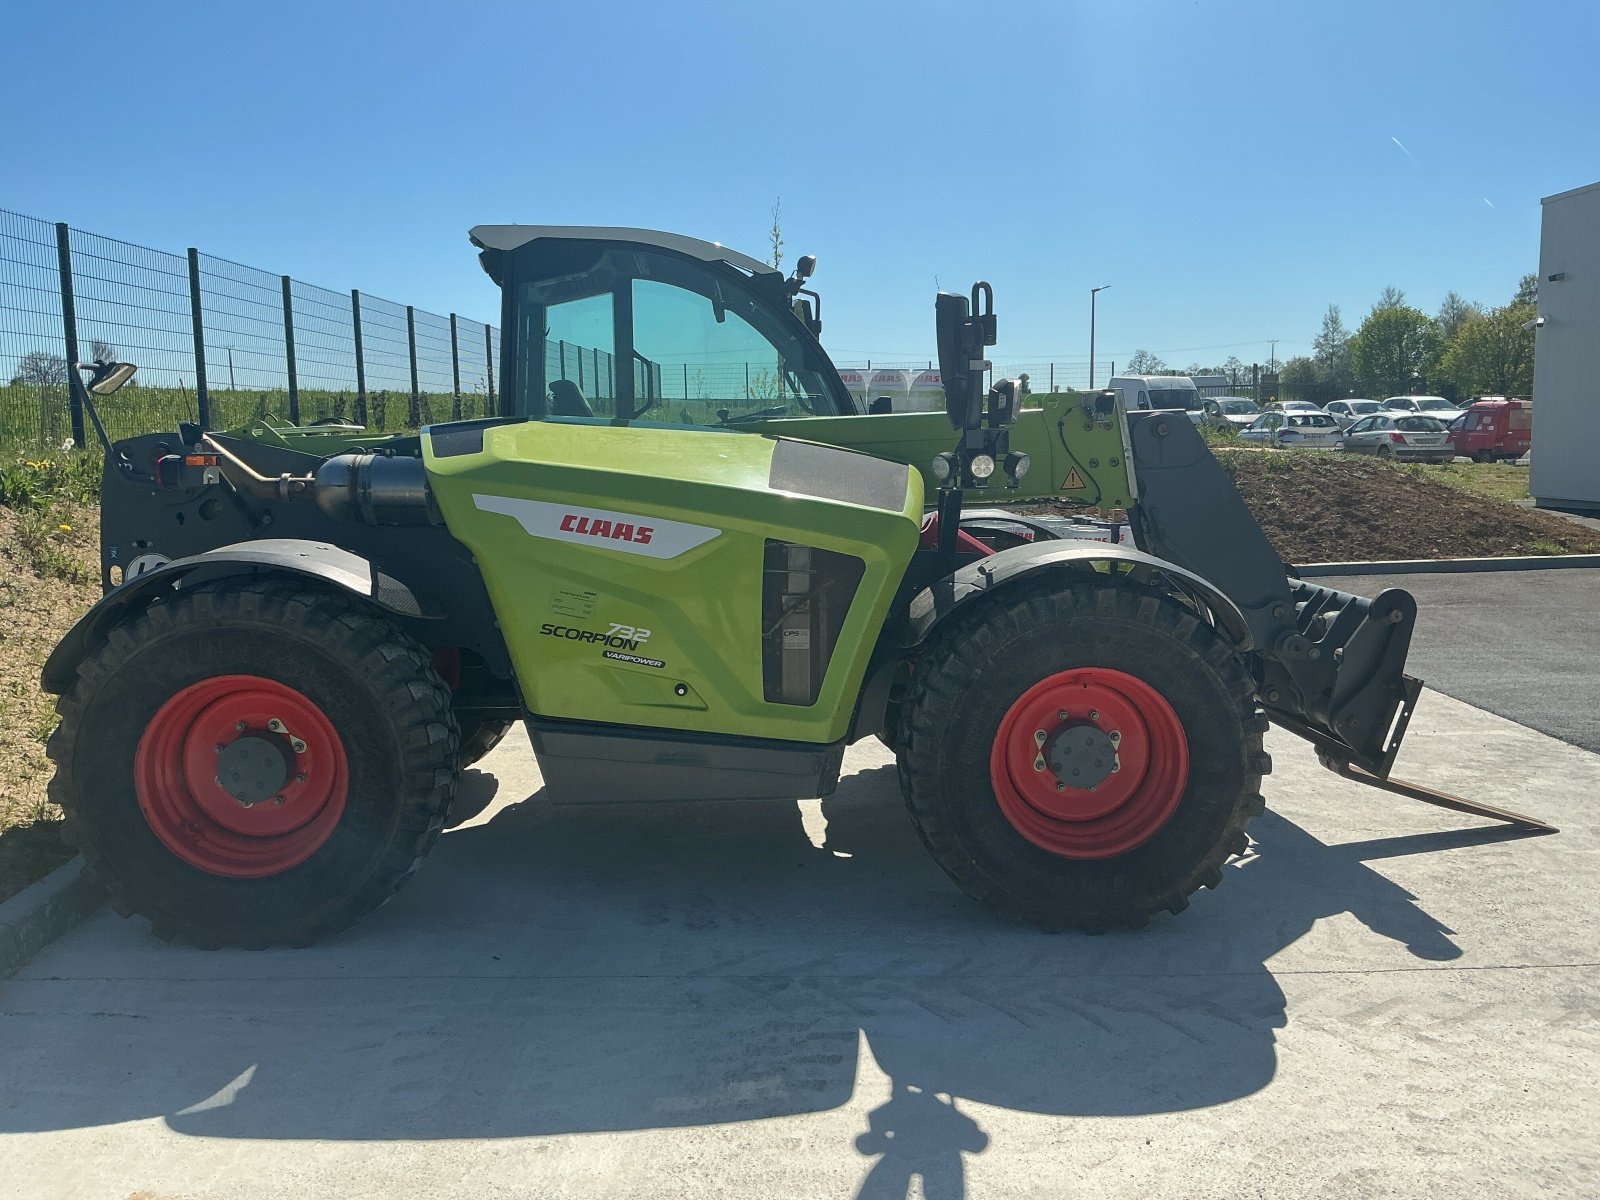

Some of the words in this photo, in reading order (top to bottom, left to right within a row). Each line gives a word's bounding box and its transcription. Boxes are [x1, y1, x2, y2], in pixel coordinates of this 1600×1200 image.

[560, 514, 654, 544] CLAAS
[539, 623, 640, 651] SCORPION
[605, 622, 651, 642] 732
[606, 651, 662, 667] VARIPOWER
